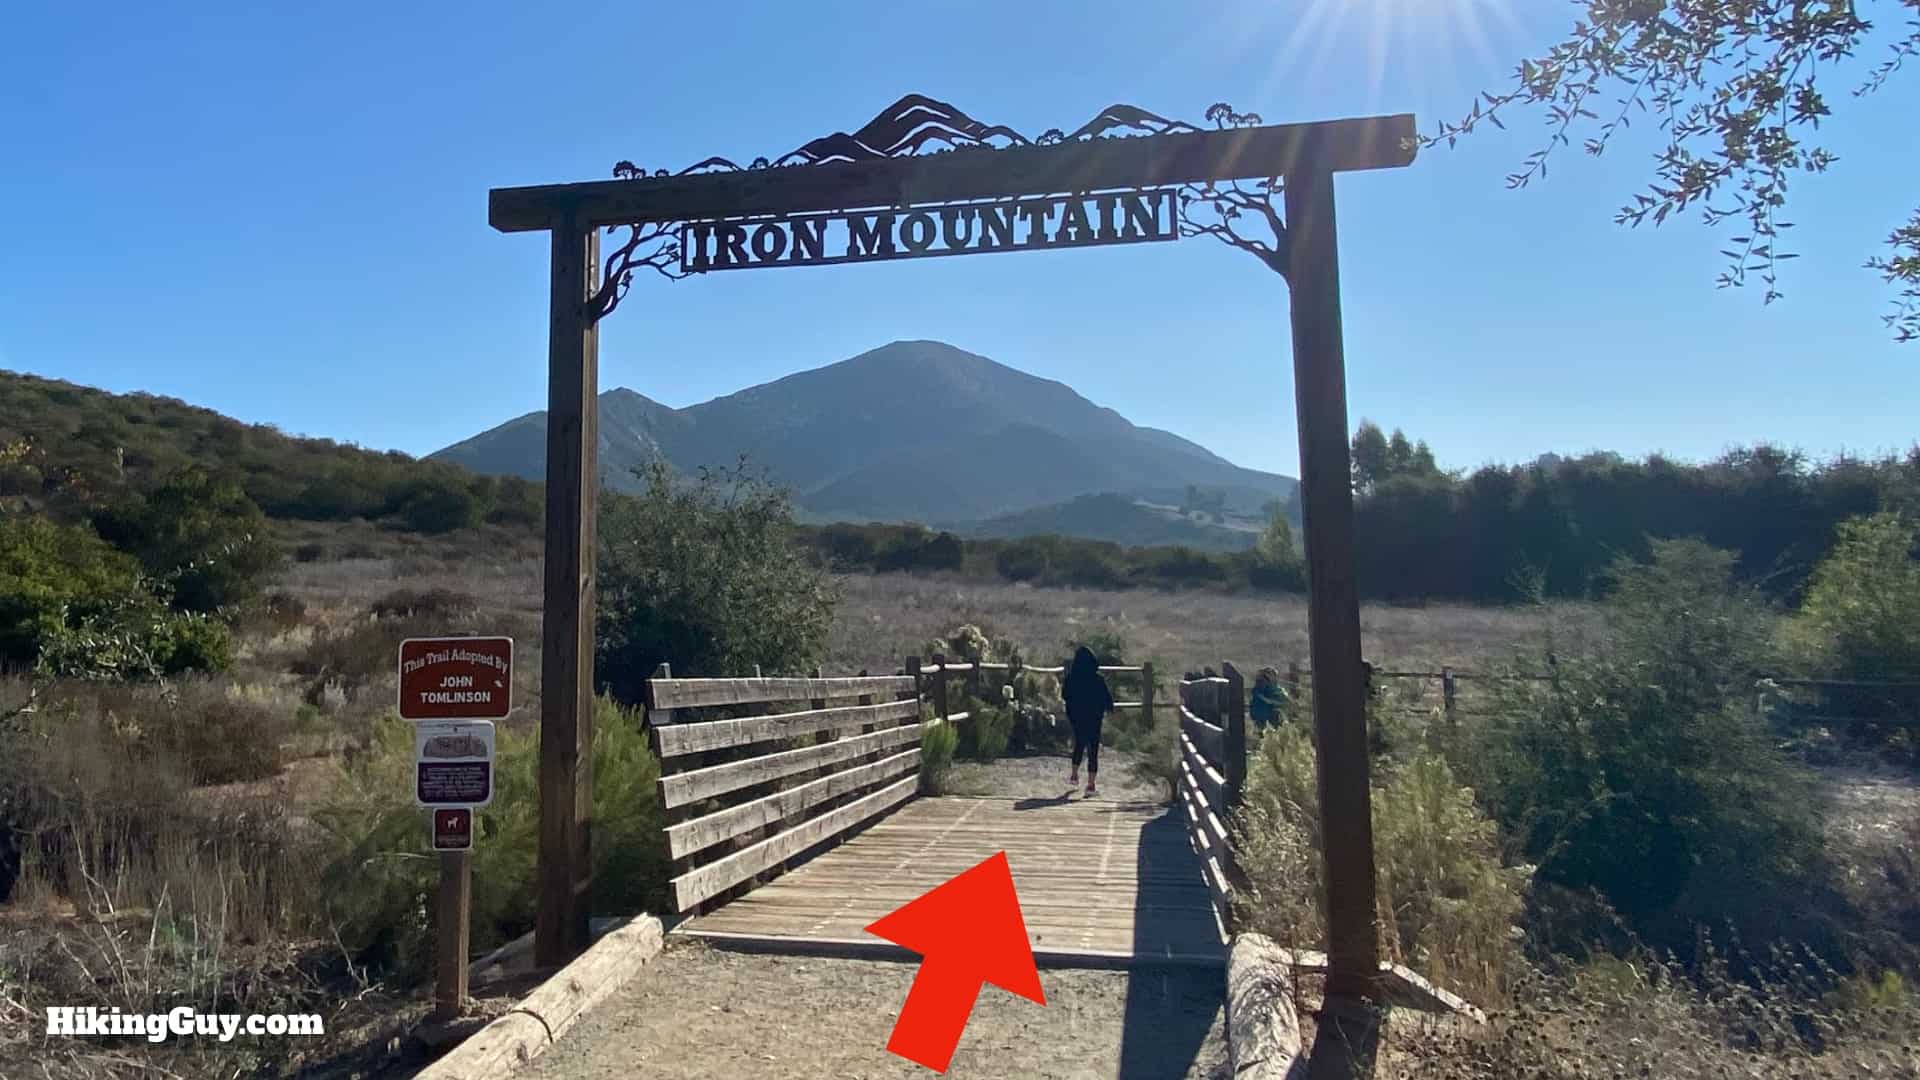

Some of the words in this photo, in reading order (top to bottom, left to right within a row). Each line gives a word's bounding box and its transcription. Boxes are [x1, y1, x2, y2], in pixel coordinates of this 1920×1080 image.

[692, 217, 827, 268] IRON
[847, 191, 1170, 257] MOUNTAIN
[404, 657, 425, 674] This
[426, 649, 449, 665] Trail
[451, 648, 494, 667] Adopted
[495, 656, 508, 675] By
[440, 676, 473, 688] JOHN
[420, 691, 491, 704] TOMLINSON
